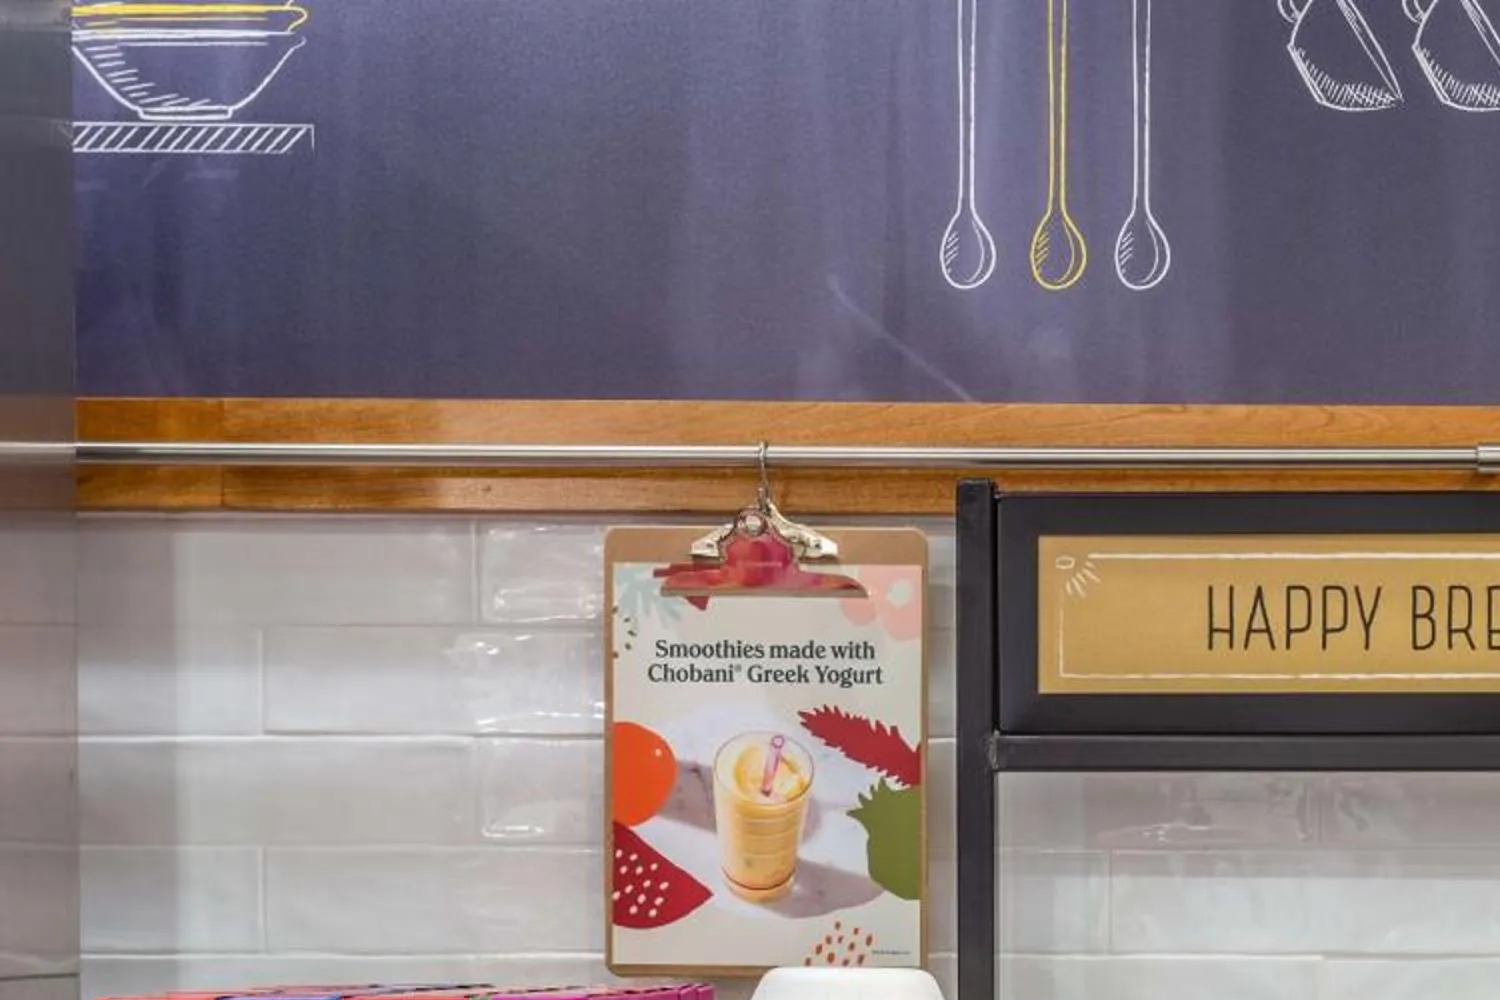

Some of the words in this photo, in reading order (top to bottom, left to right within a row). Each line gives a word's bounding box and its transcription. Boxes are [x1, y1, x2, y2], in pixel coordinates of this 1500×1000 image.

[1207, 584, 1382, 651] HAPPY
[655, 639, 765, 659] Smoothies
[769, 640, 827, 660] made
[831, 641, 876, 660] with
[747, 664, 810, 684] Greek
[815, 665, 883, 689] Yogurt
